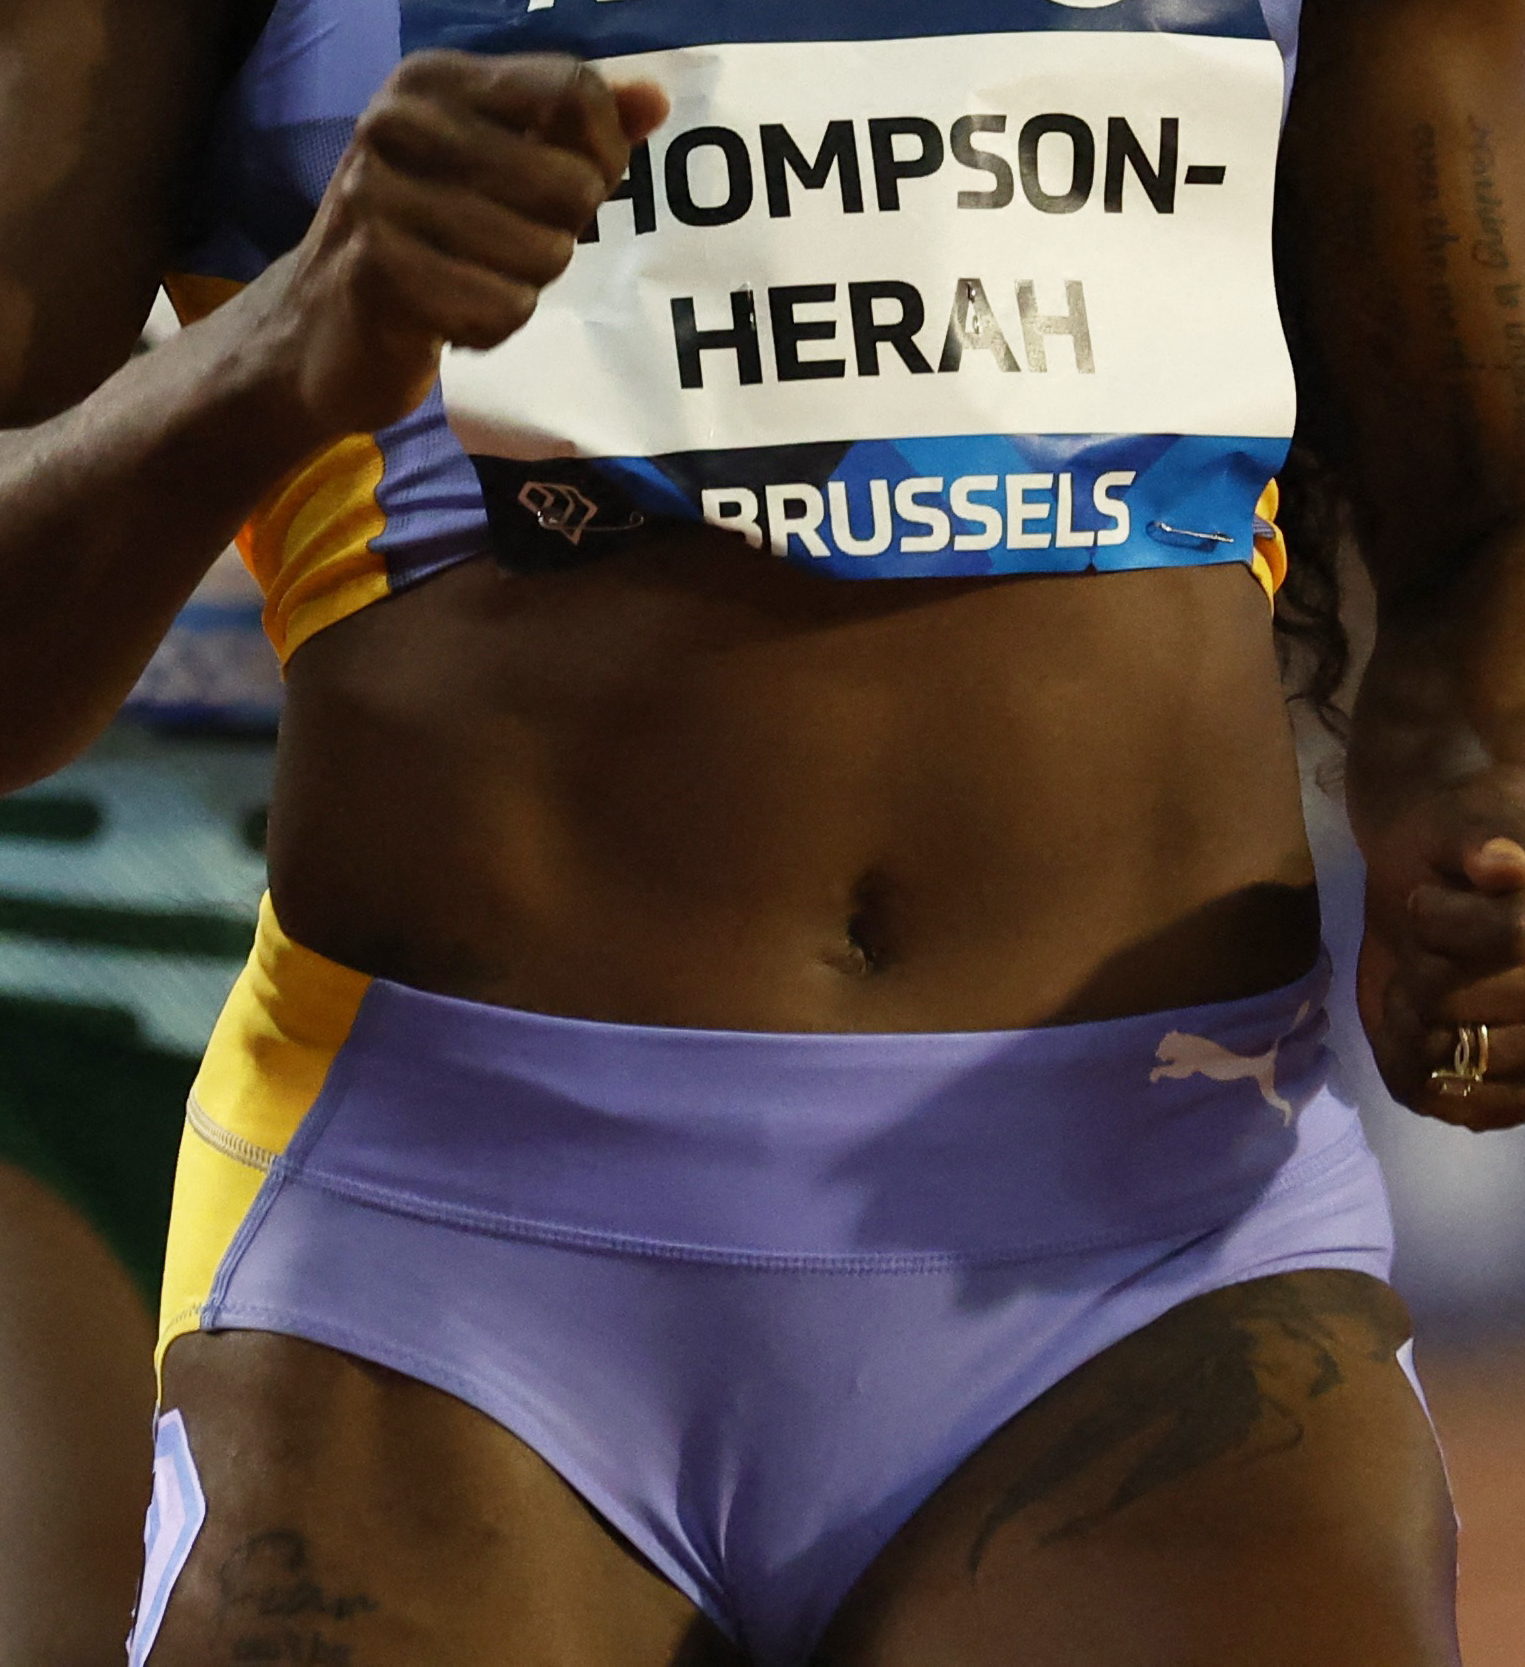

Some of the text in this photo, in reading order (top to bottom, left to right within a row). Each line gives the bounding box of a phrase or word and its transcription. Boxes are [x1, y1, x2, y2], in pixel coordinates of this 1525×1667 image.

[577, 113, 1226, 245] HOMPSON-
[669, 278, 1096, 389] HERAH
[702, 470, 1137, 557] BRUSSELS
